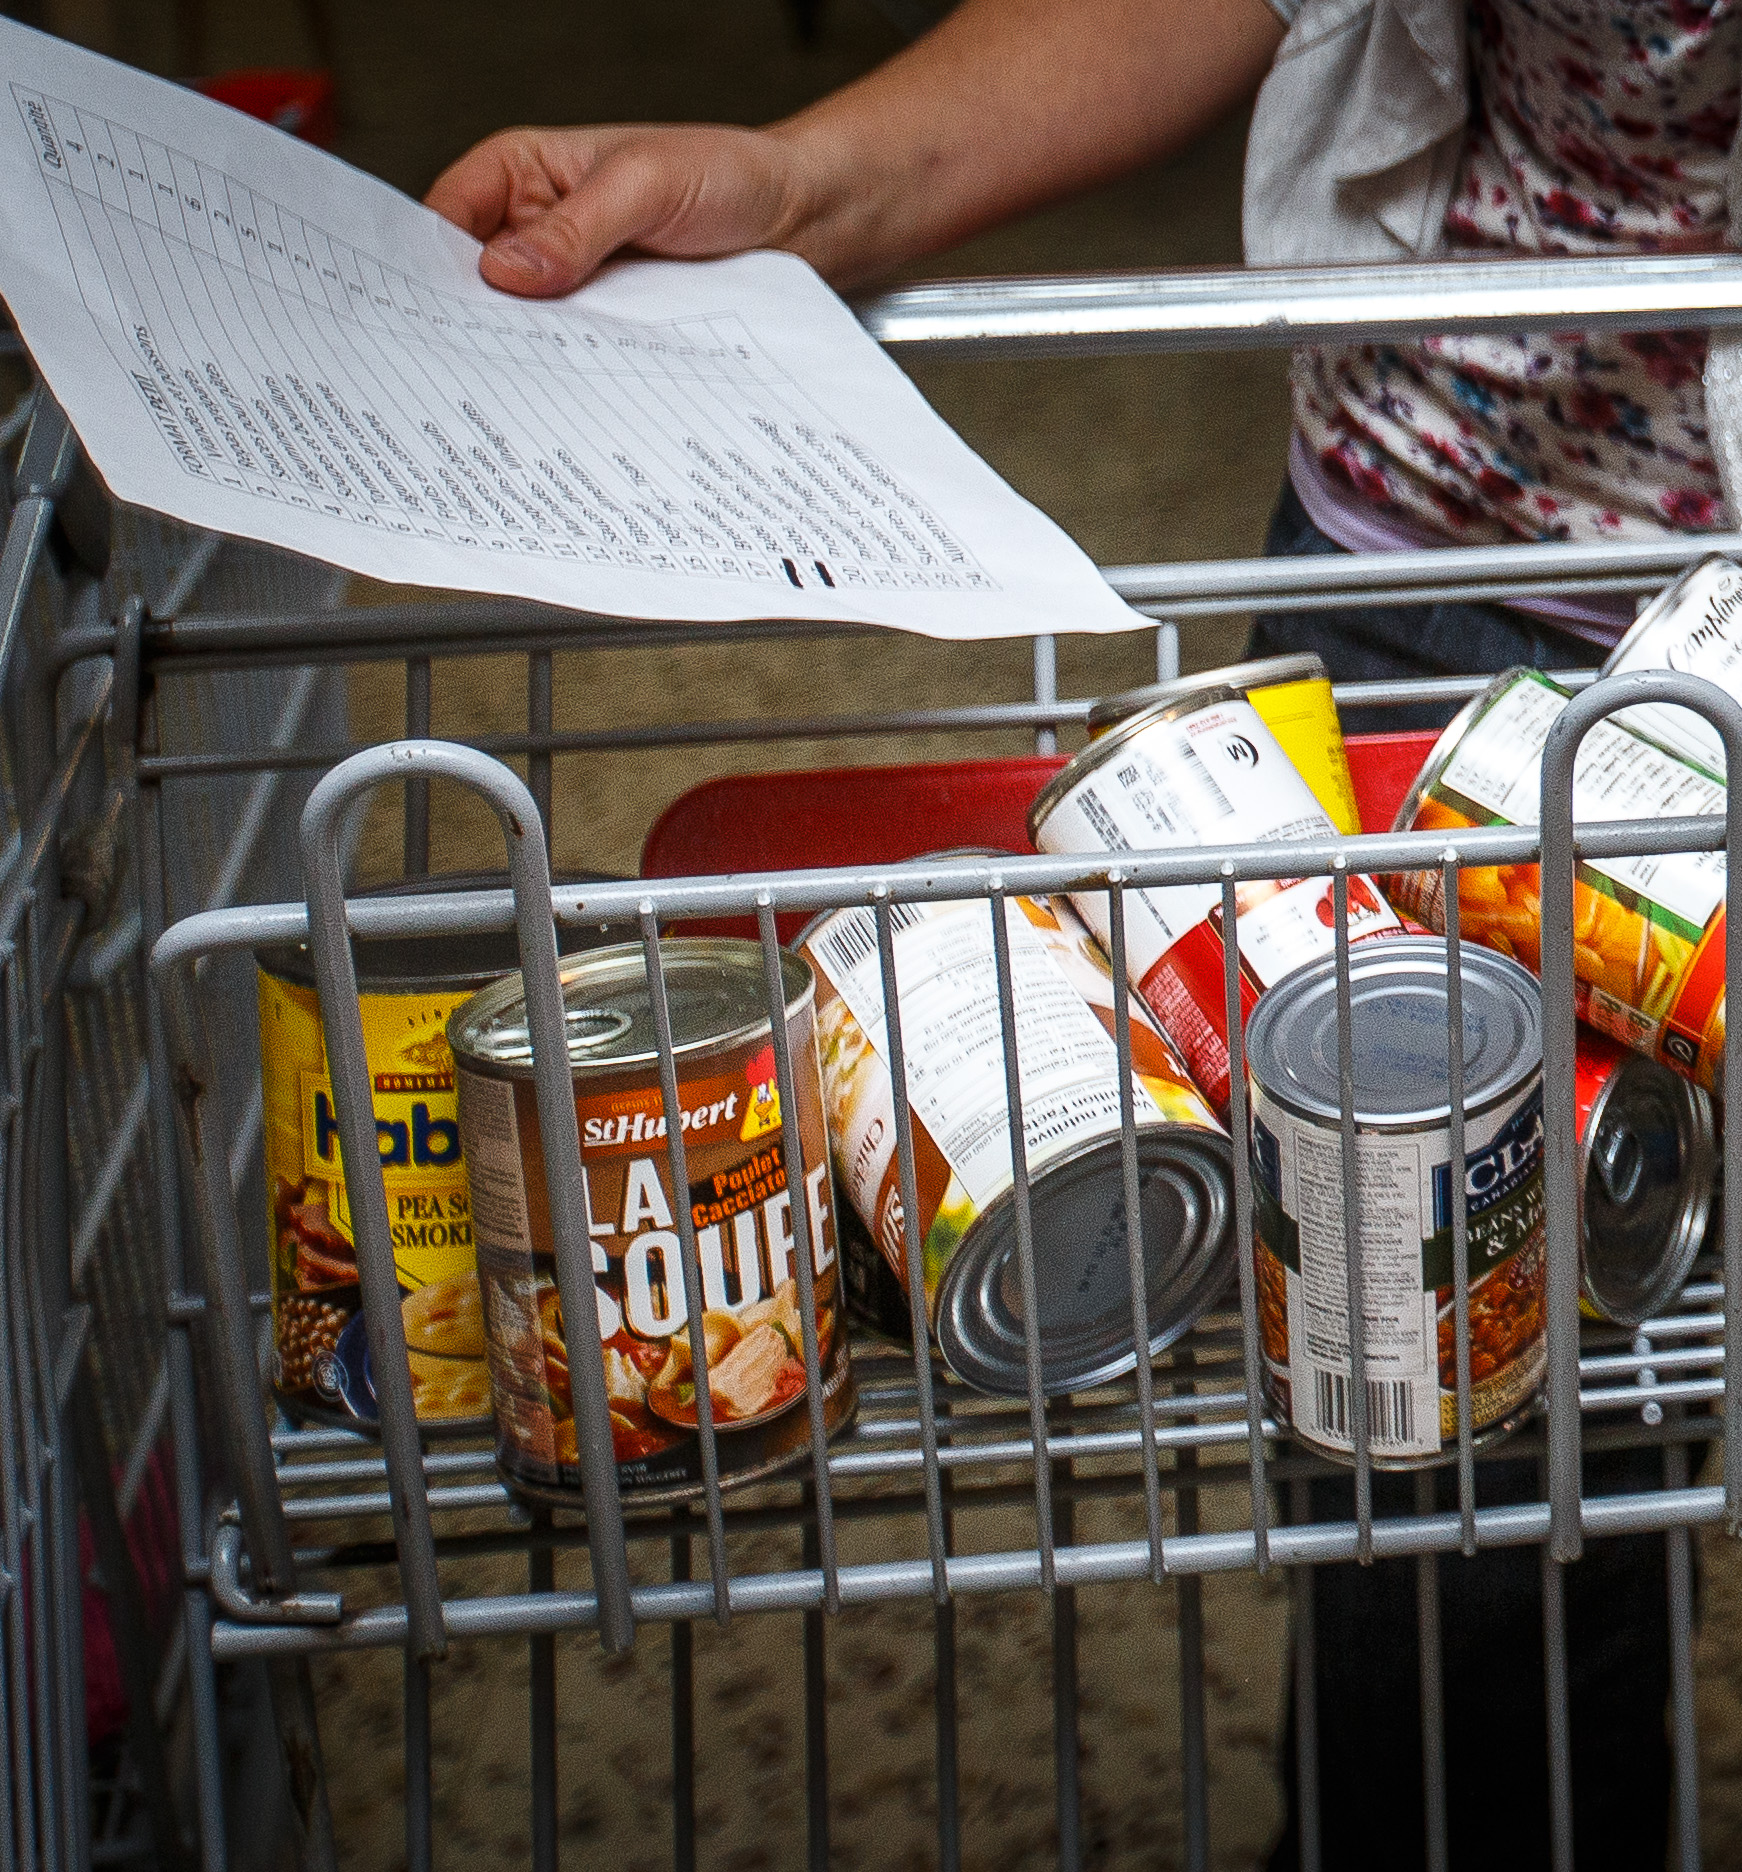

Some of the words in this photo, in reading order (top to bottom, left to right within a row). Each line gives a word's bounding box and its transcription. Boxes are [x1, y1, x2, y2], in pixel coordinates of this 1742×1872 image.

[130, 370, 169, 413] PETIT
[178, 404, 222, 459] Viandes
[382, 1074, 453, 1091] HOMEMA
[397, 1194, 445, 1221] PEA
[582, 1157, 674, 1237] LA
[691, 1168, 786, 1229] Cacciato
